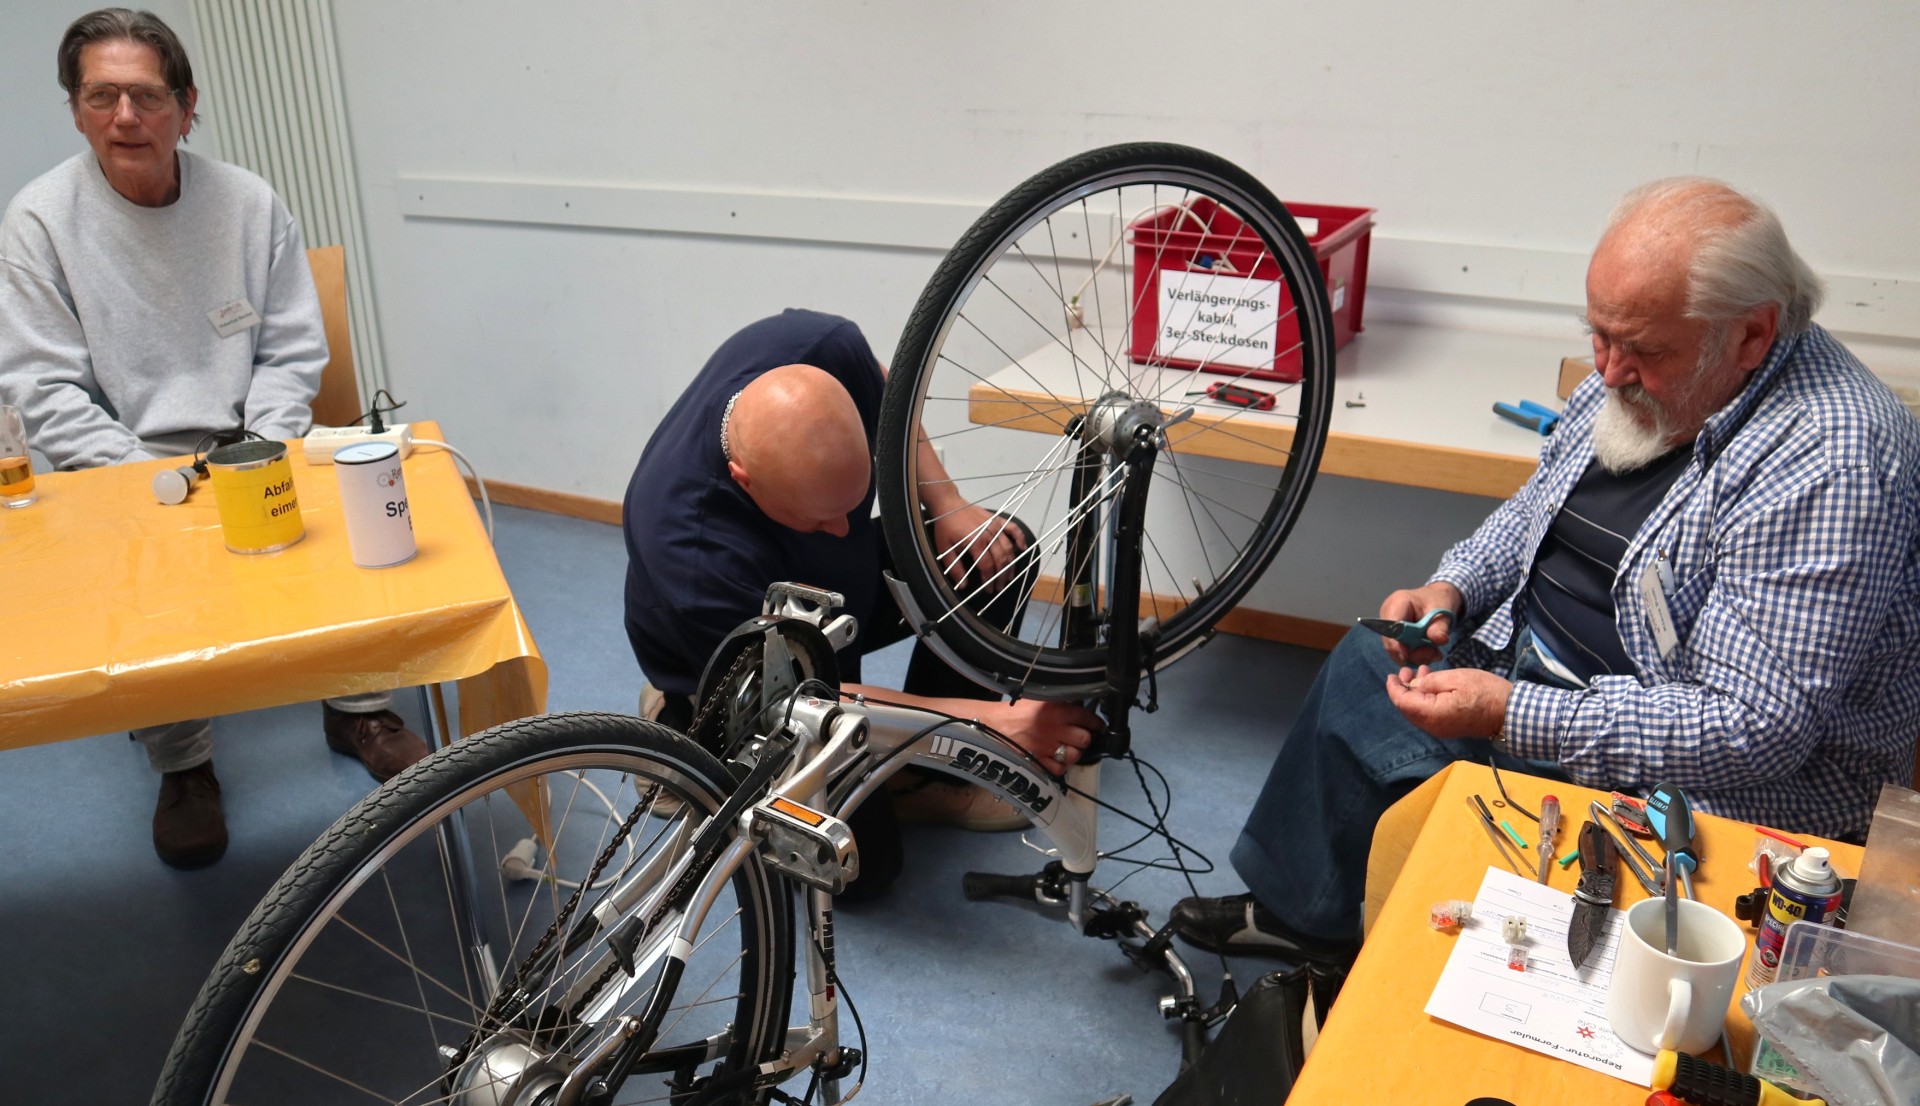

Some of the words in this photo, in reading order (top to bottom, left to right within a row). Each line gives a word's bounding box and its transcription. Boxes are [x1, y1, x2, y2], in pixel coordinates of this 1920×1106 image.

[1167, 287, 1271, 311] Verlängerungs-
[1197, 310, 1237, 328] kabel,
[1166, 326, 1268, 350] 3er-Steckdosen
[947, 747, 1053, 814] PEGASUS
[1772, 894, 1802, 917] WD-40
[1509, 1029, 1623, 1071] Reparatur-Formular
